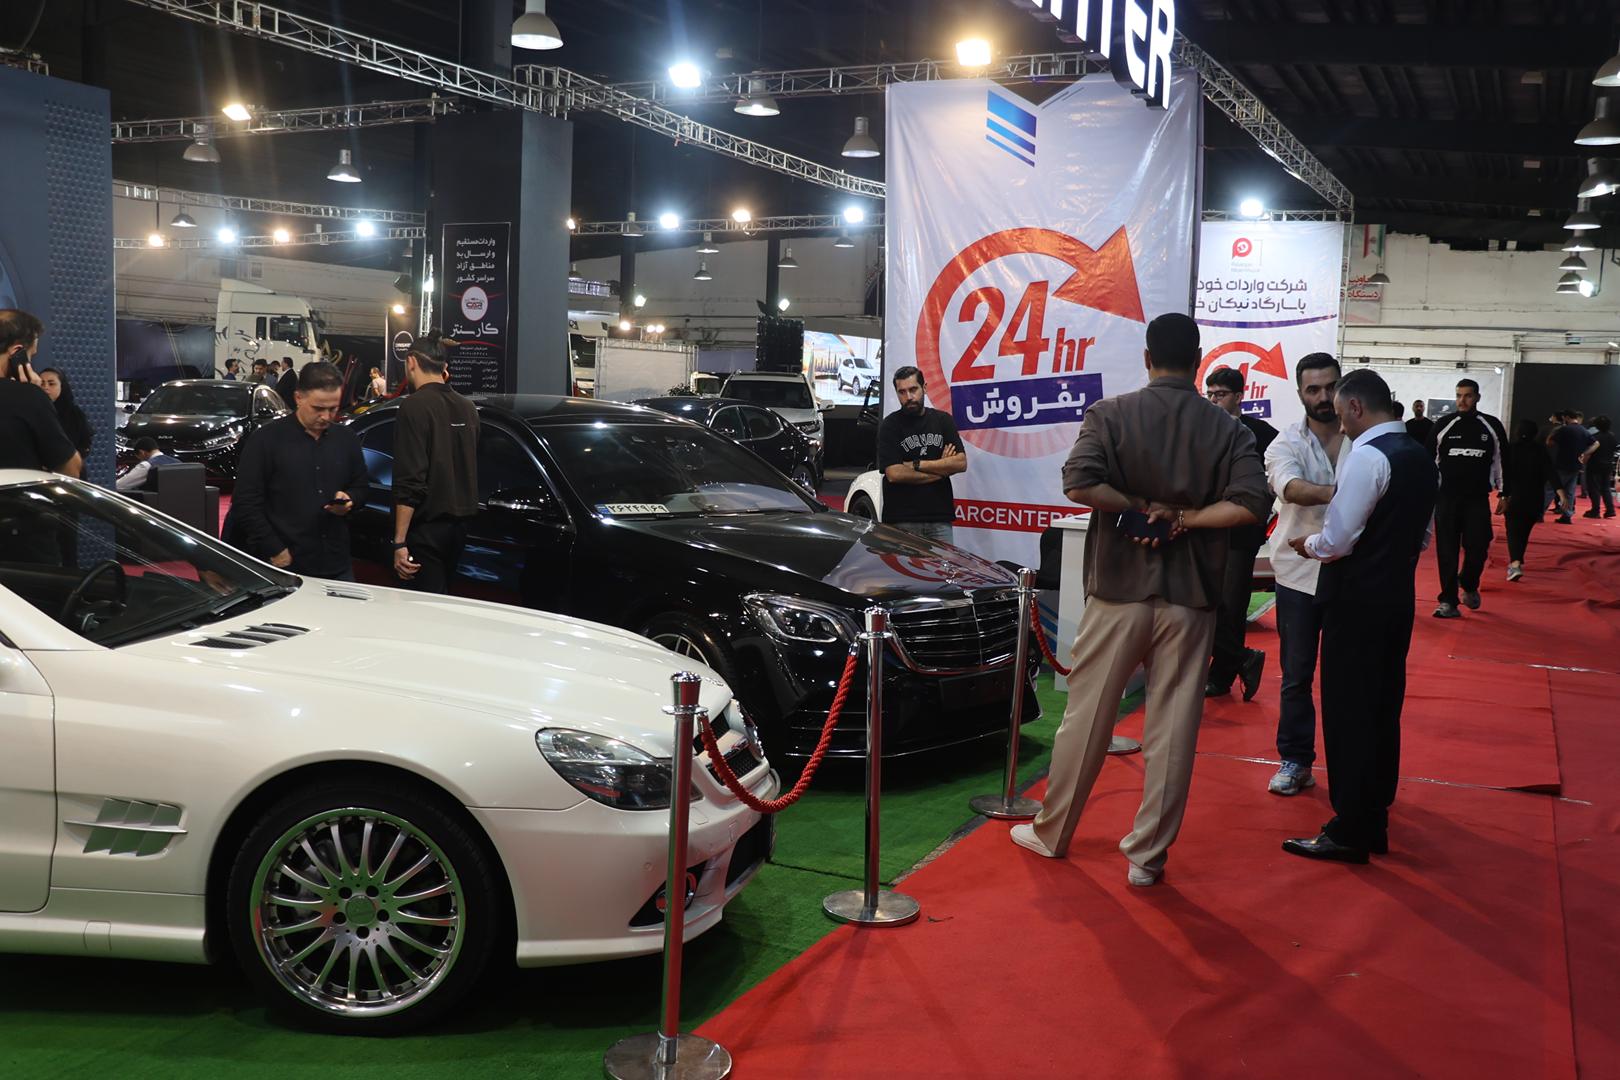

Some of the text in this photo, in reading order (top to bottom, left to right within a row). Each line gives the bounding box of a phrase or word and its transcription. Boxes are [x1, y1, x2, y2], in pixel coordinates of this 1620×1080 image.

[1197, 278, 1307, 294] شرکت واردات خود
[1208, 296, 1250, 312] نیکان
[966, 383, 1086, 424] بفروش
[1448, 448, 1486, 457] SPORT
